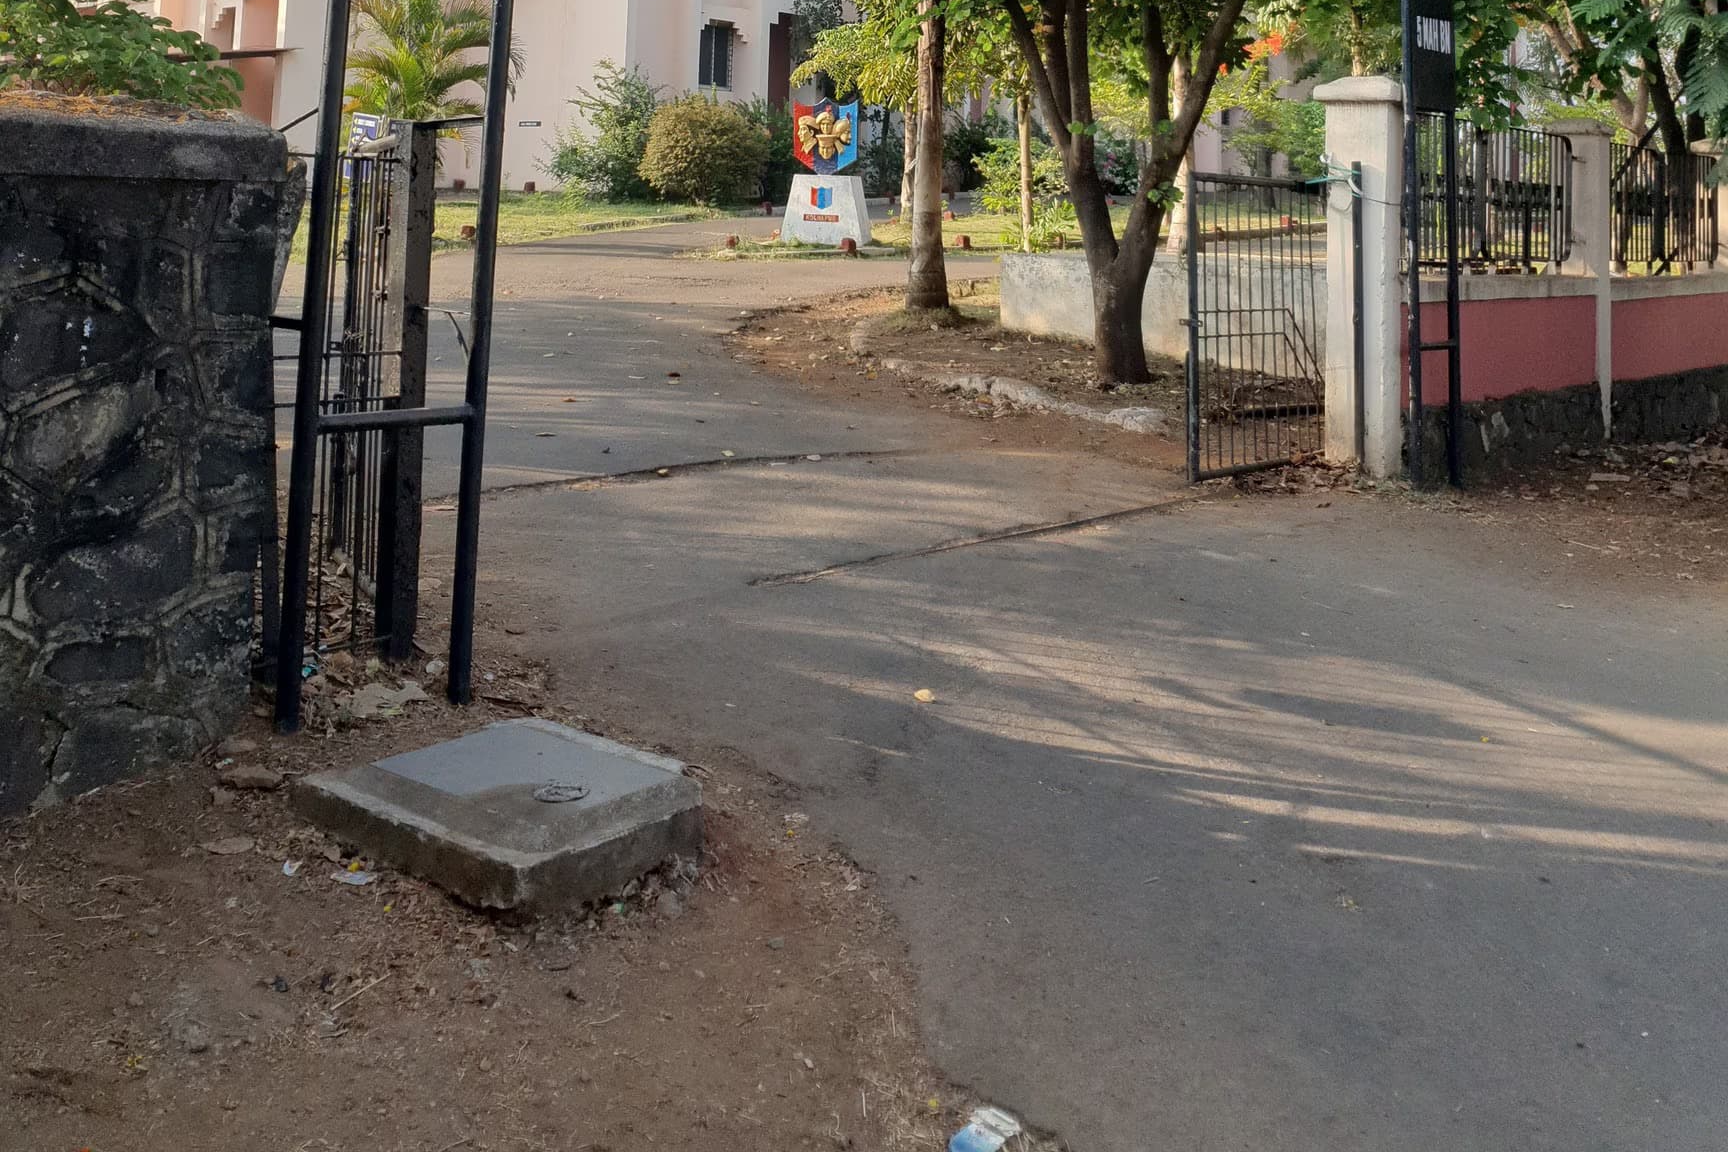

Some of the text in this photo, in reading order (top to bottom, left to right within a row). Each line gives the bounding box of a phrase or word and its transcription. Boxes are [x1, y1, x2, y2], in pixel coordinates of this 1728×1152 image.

[1416, 15, 1451, 54] 5 MAH BN
